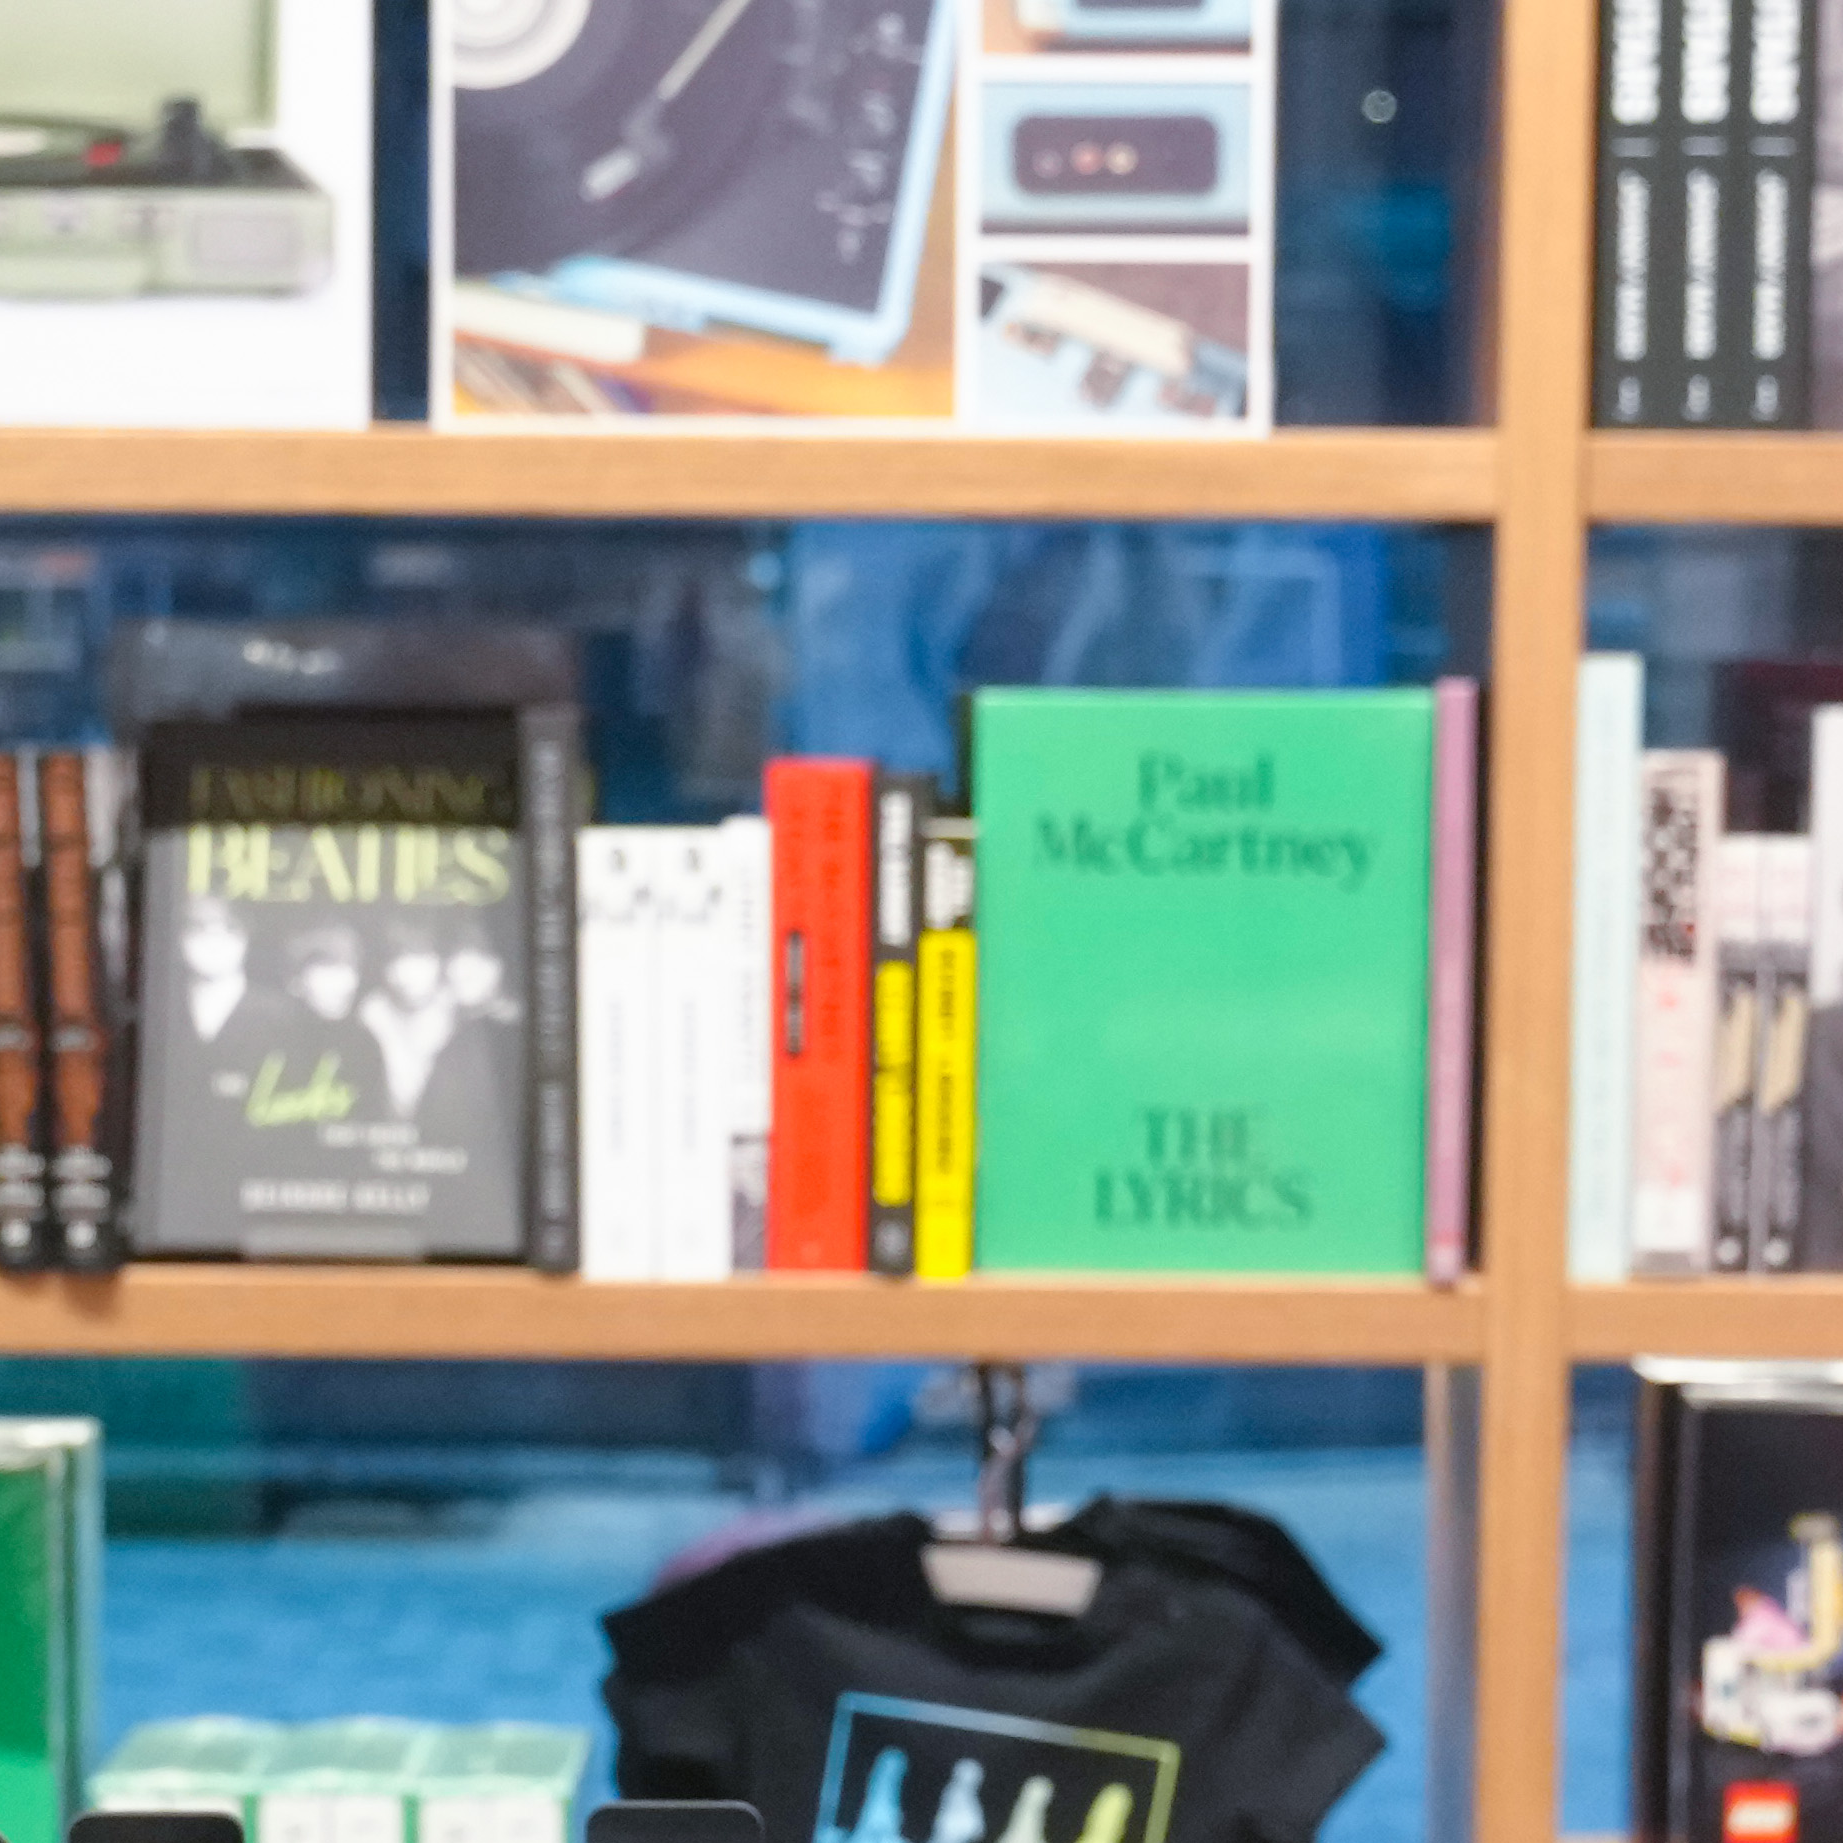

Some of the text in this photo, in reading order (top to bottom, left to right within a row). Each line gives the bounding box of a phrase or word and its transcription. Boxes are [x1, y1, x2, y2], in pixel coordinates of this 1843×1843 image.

[1137, 750, 1274, 811] Paul
[188, 823, 510, 905] BEATLES
[1035, 814, 1374, 892] McCartney
[1143, 1108, 1259, 1162] THE
[1094, 1173, 1310, 1229] LYRICS
